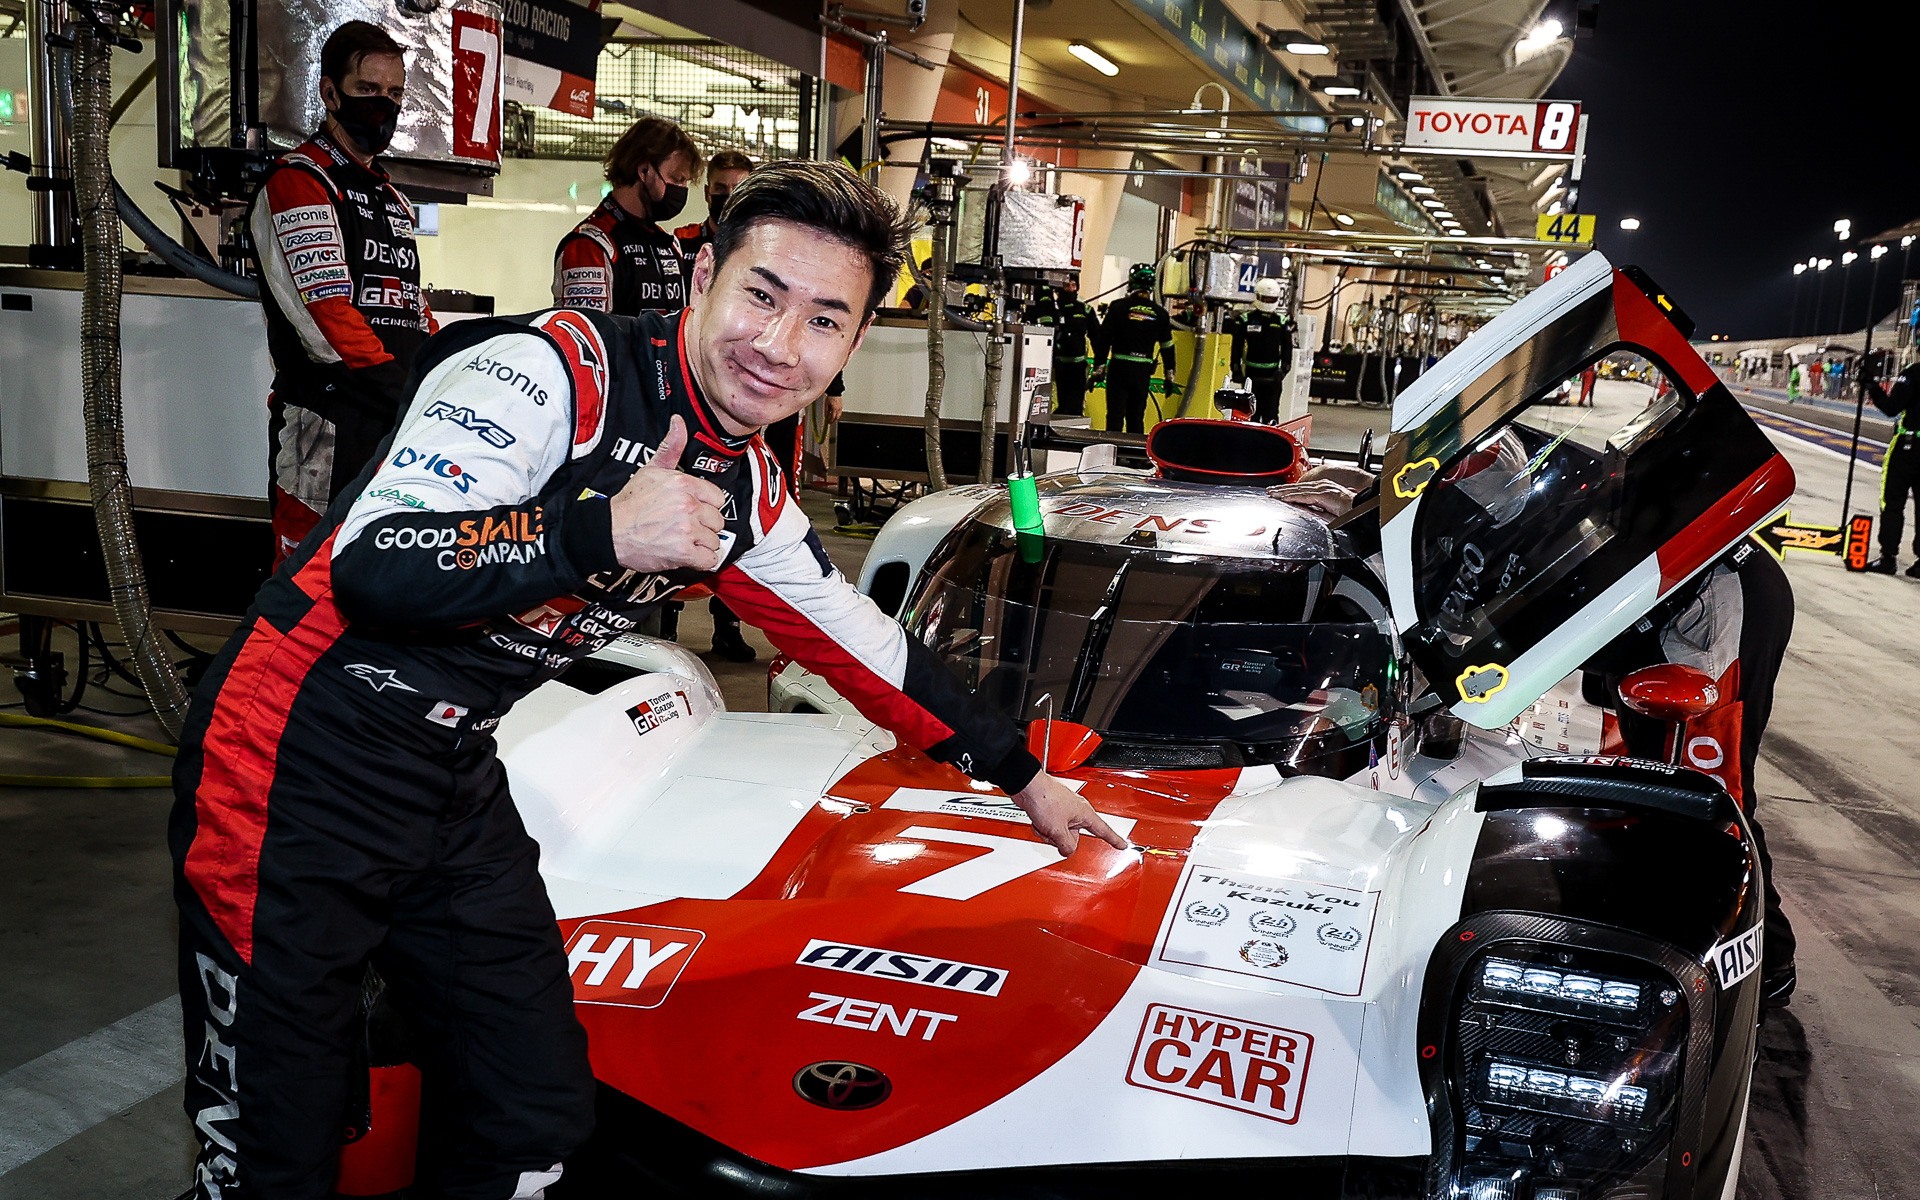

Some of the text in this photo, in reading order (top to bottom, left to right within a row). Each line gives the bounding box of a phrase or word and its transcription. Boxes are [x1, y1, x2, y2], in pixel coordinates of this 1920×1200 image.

[503, 0, 529, 27] ZOO
[531, 5, 570, 42] RACING
[459, 26, 498, 143] 7
[974, 86, 990, 125] 31
[1415, 102, 1575, 150] TOYOTA 8
[278, 209, 329, 228] Acronis
[1546, 214, 1580, 242] 44
[286, 231, 332, 247] RAYS
[299, 268, 345, 283] HAYASHI
[567, 270, 602, 281] Acronis
[319, 287, 349, 297] MICHELIN
[361, 287, 402, 305] GR
[461, 355, 549, 407] Acronis
[424, 400, 516, 449] RAYS
[694, 457, 718, 472] GR
[375, 527, 457, 550] GOOD
[1849, 518, 1871, 569] STOP
[1222, 663, 1241, 671] GR
[674, 690, 693, 716] 7
[634, 711, 659, 734] GR
[1618, 762, 1675, 775] Racing
[939, 806, 1018, 818] CHAMPIONSHIP
[959, 805, 996, 814] WORLD
[896, 825, 1069, 901] 7
[1199, 874, 1361, 907] Thank You
[1226, 891, 1333, 914] Kazuki
[1187, 918, 1222, 927] WINNER
[1252, 928, 1289, 939] WINNER
[1319, 941, 1358, 951] WINNER
[570, 933, 689, 990] HY
[800, 944, 1001, 992] AISIN
[797, 992, 958, 1041] ZENT
[1153, 1011, 1298, 1064] HYPER
[1143, 1038, 1291, 1112] CAR
